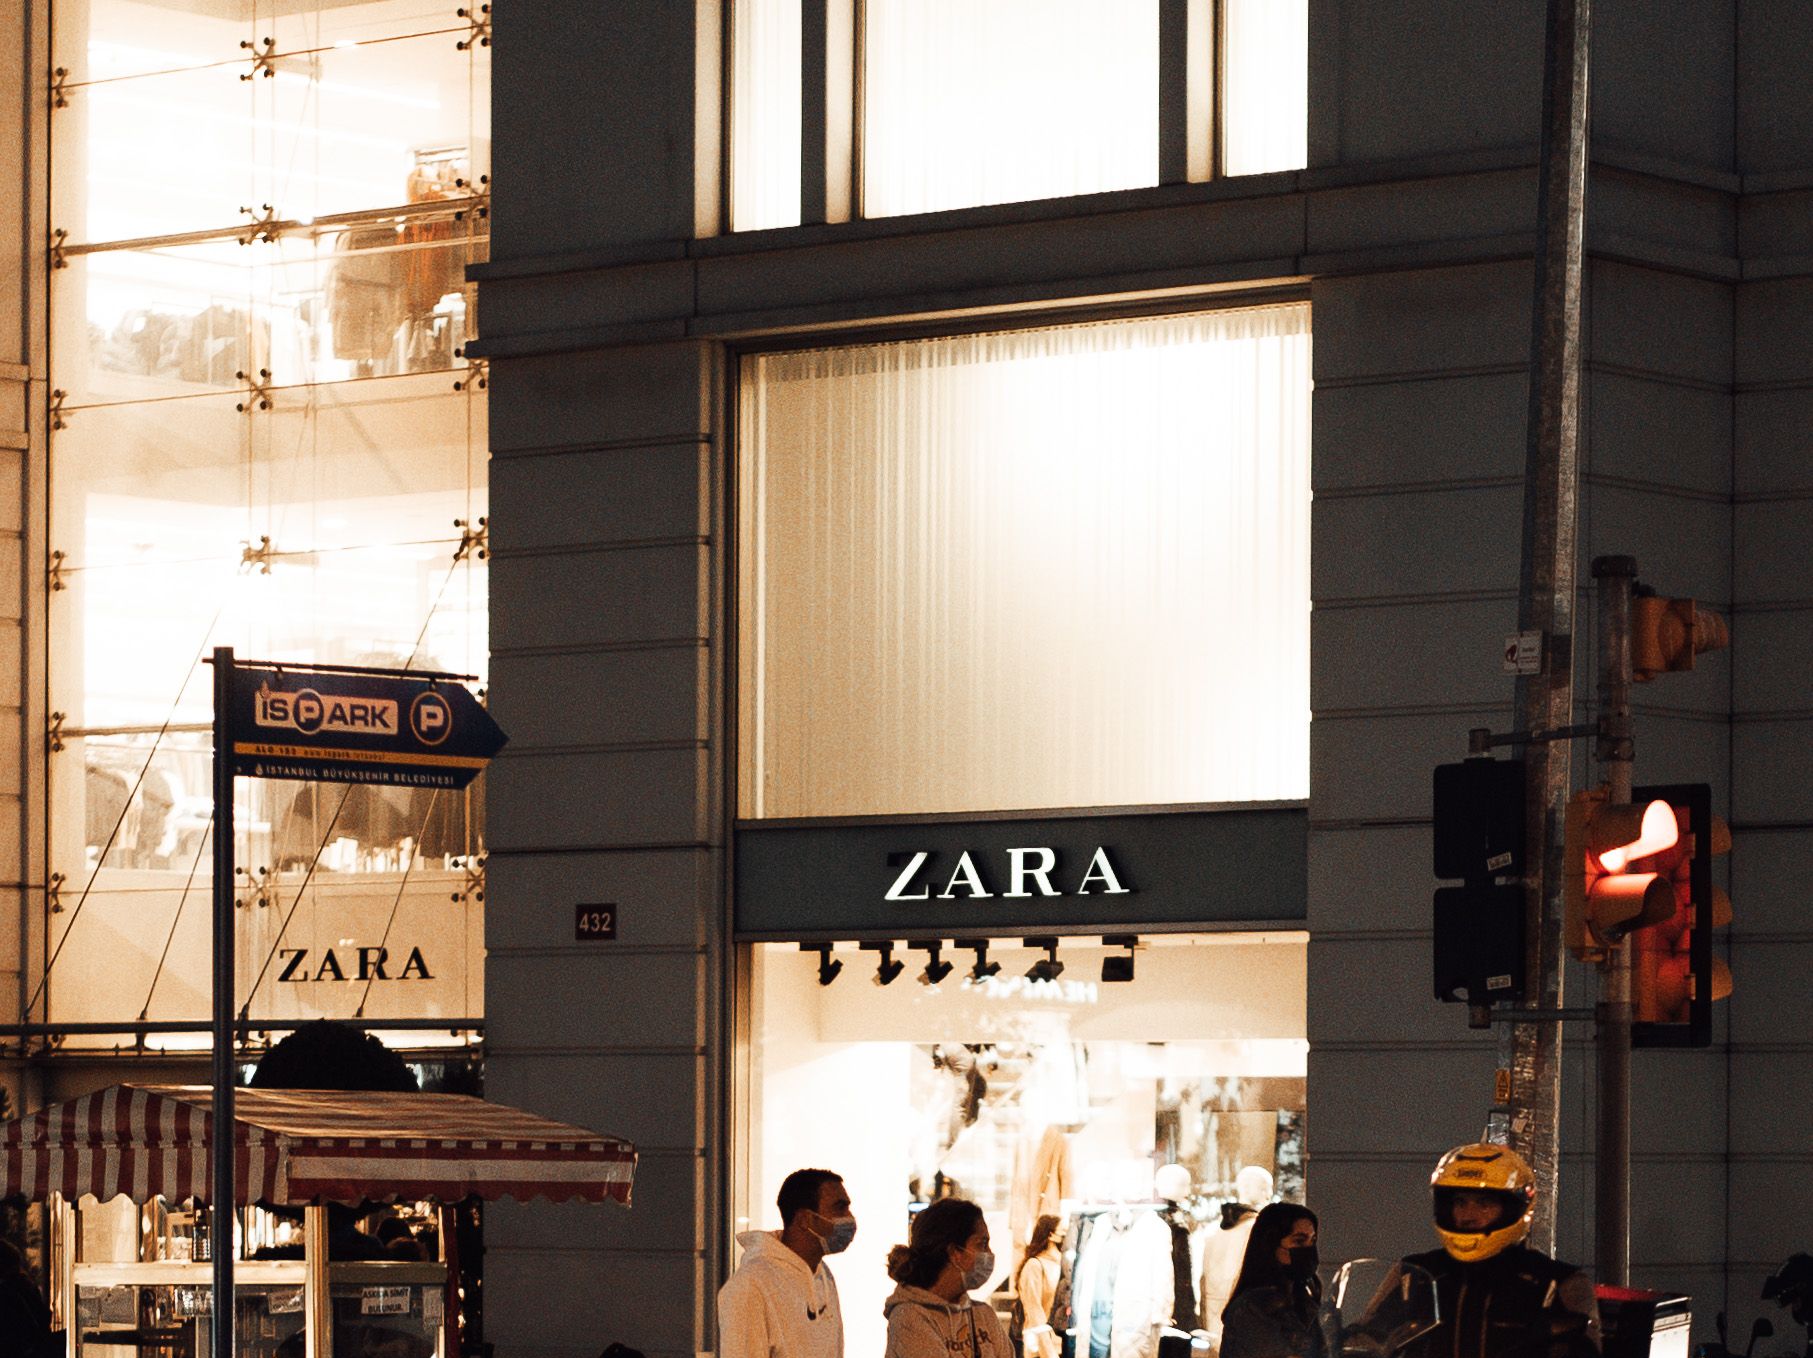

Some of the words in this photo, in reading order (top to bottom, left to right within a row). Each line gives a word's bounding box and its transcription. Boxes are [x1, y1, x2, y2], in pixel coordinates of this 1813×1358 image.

[420, 704, 444, 732] P
[885, 847, 1130, 901] ZARA
[580, 913, 610, 931] 432
[278, 946, 435, 981] ZARA
